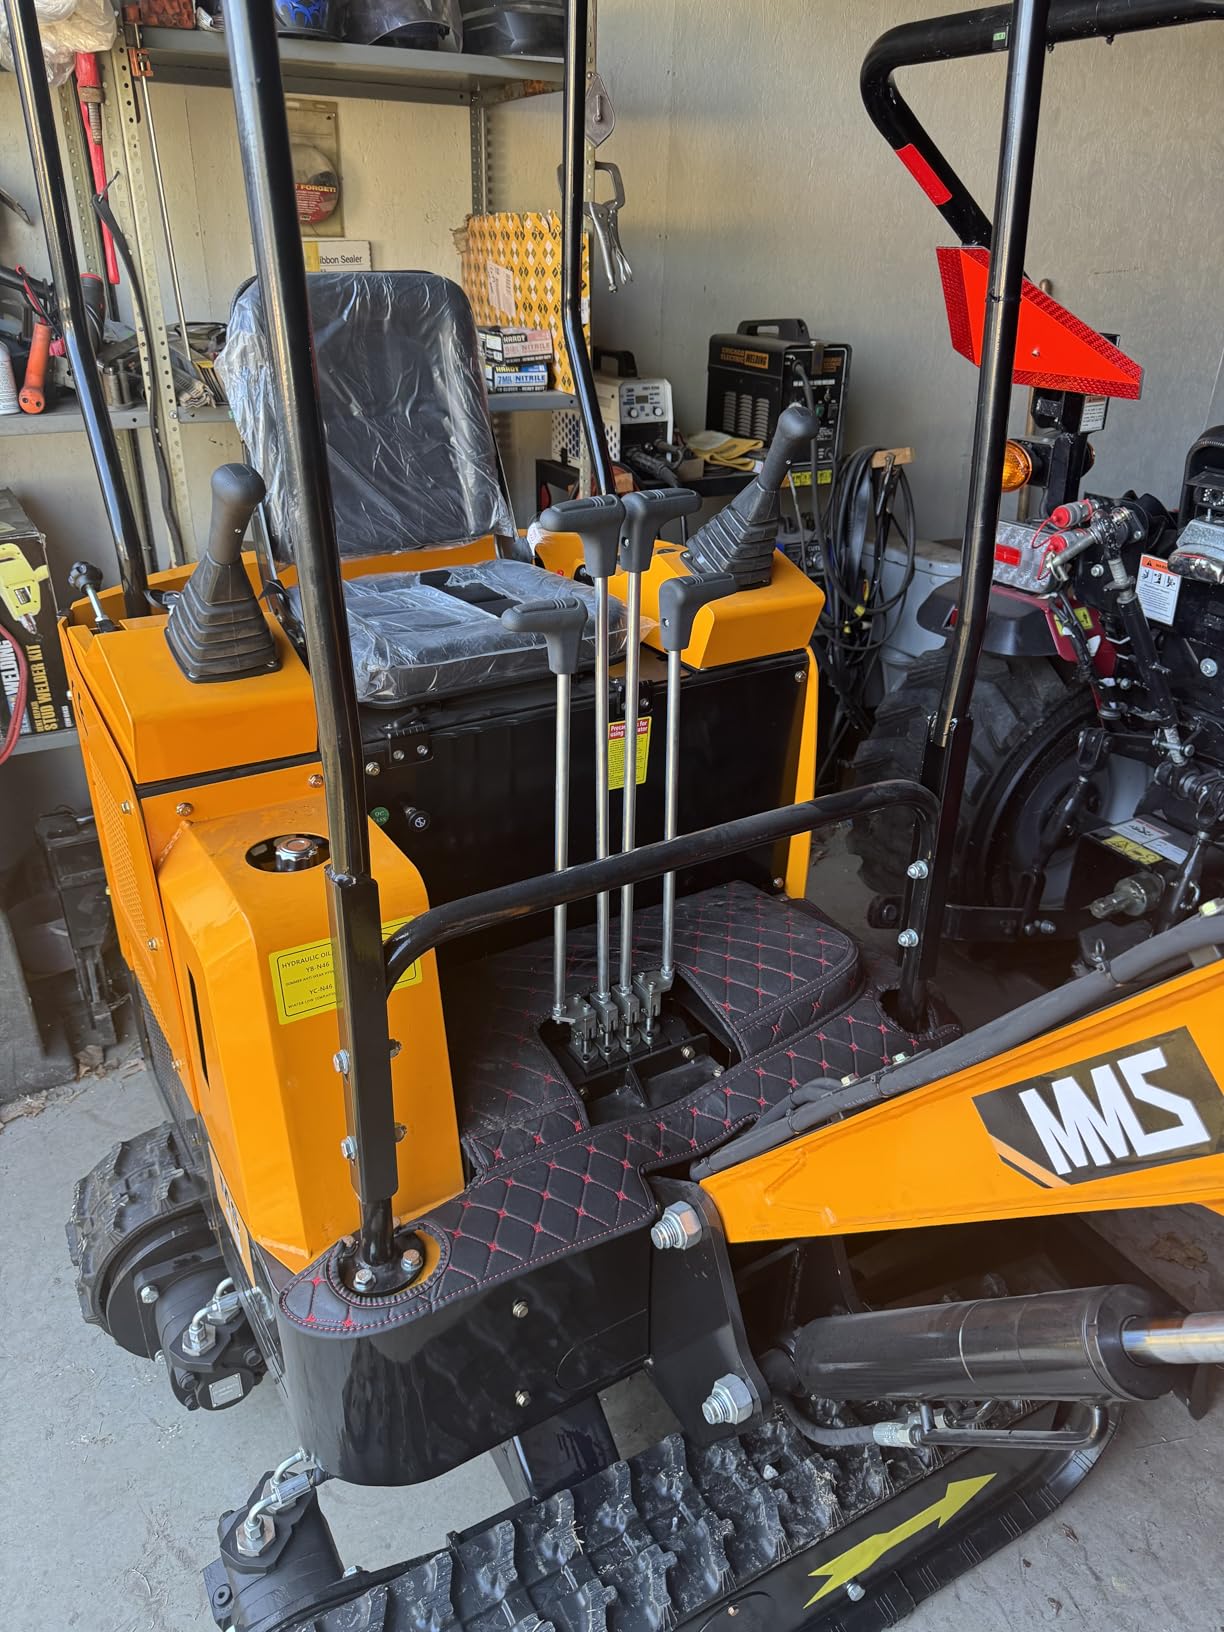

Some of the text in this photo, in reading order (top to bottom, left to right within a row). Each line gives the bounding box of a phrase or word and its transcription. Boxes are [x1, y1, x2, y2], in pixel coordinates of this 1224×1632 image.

[320, 256, 339, 264] ibbon
[504, 335, 525, 344] HARDY
[25, 644, 58, 730] STUD WELDER KIT
[282, 954, 319, 968] HYDRAULIC
[306, 962, 330, 972] YB-N46
[310, 984, 333, 995] YC-N46
[1018, 1046, 1210, 1176] MMS
